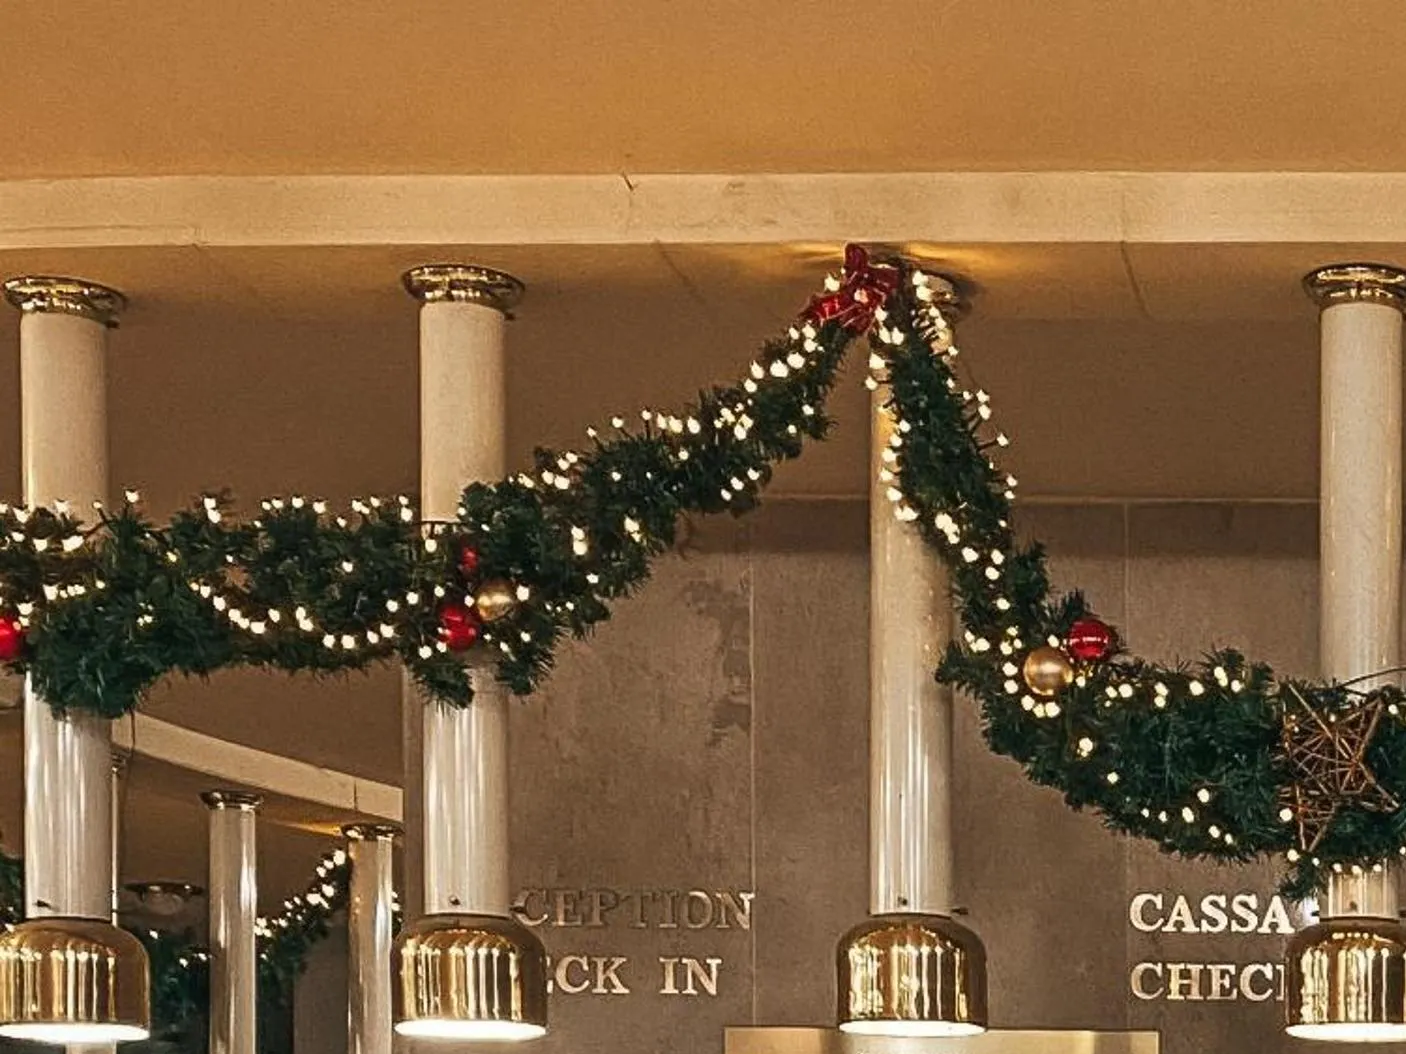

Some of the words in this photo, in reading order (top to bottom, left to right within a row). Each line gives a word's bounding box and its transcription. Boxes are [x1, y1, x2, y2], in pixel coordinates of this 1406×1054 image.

[512, 887, 756, 931] CEPTION
[1129, 892, 1296, 934] CASSA
[545, 955, 631, 994] CK
[658, 957, 722, 995] IN
